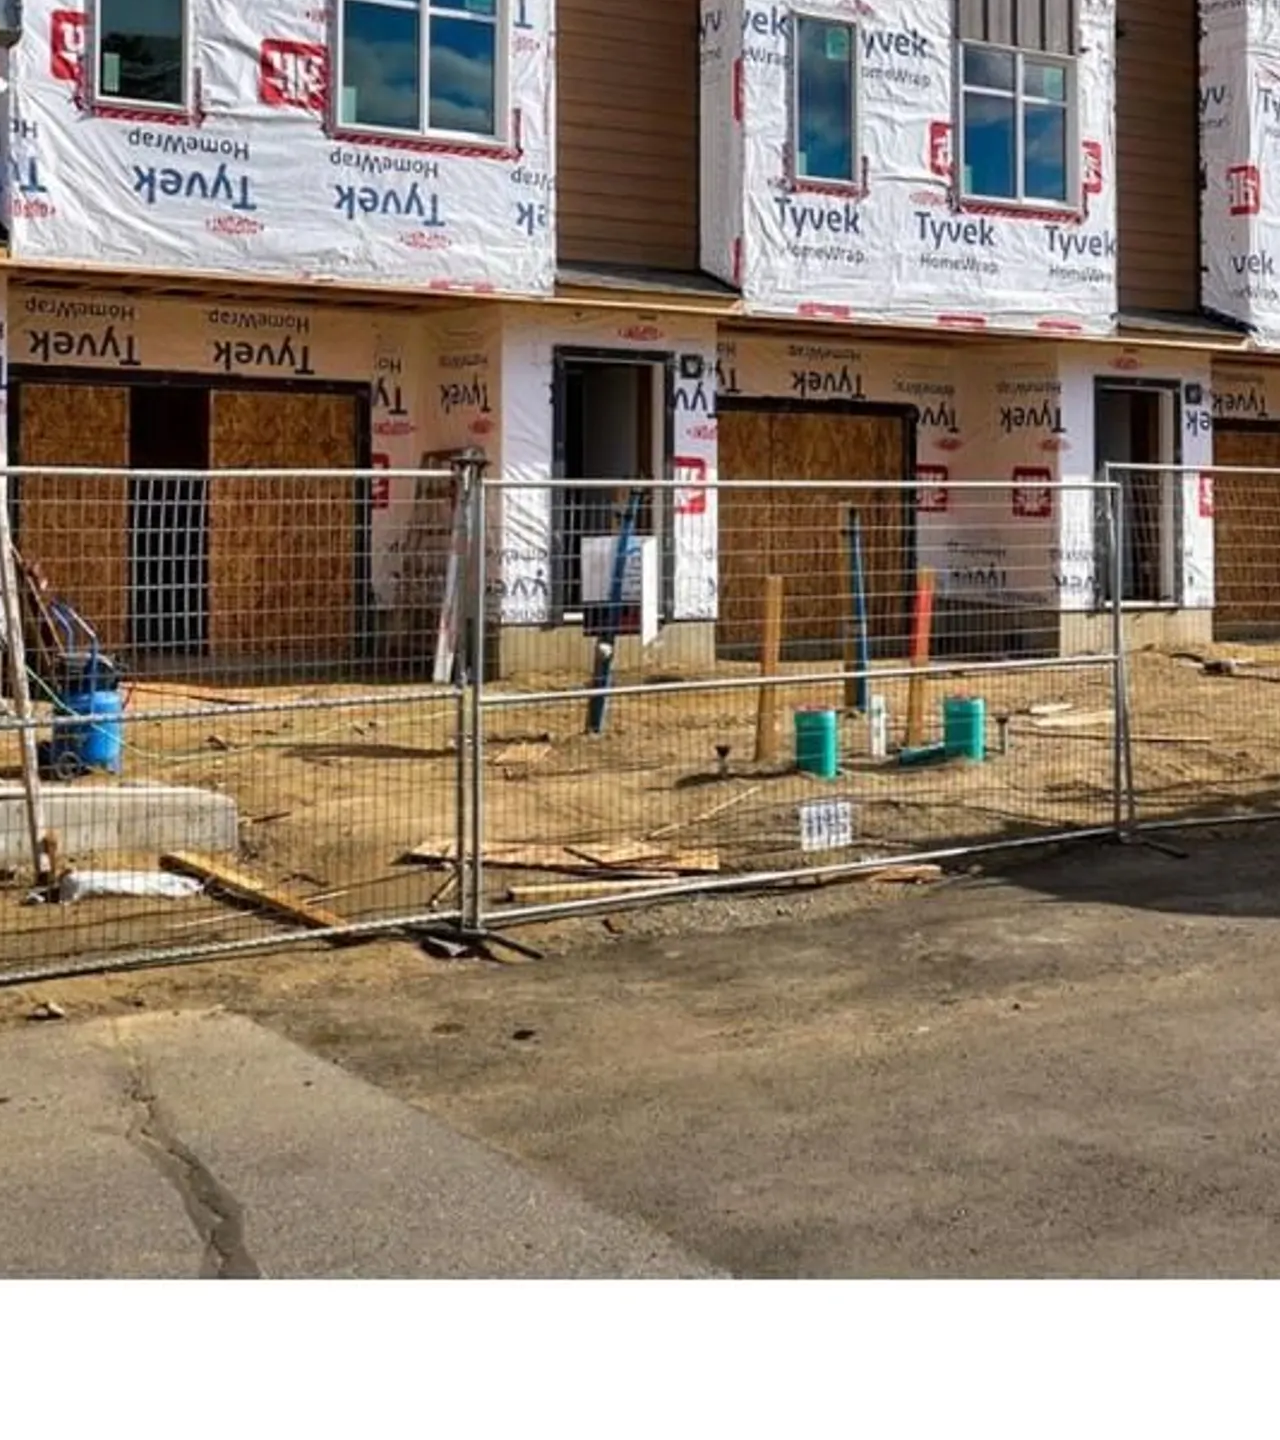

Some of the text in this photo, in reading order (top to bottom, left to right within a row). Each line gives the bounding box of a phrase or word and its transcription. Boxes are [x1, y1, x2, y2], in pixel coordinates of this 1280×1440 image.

[128, 127, 250, 161] HomeWrap
[330, 146, 439, 179] HomeWrap
[133, 163, 257, 211] Tyvek
[334, 182, 446, 227] Tyvek
[774, 195, 859, 237] Tyvek
[914, 211, 995, 248] Tyvek
[25, 296, 135, 321] HomeWrap
[208, 309, 310, 333] HomeWrap
[29, 325, 141, 367] Tyvek
[214, 336, 316, 376] Tyvek
[439, 373, 492, 414] Tyvek
[790, 365, 866, 400] Tyvek
[1000, 400, 1067, 433] Tyvek
